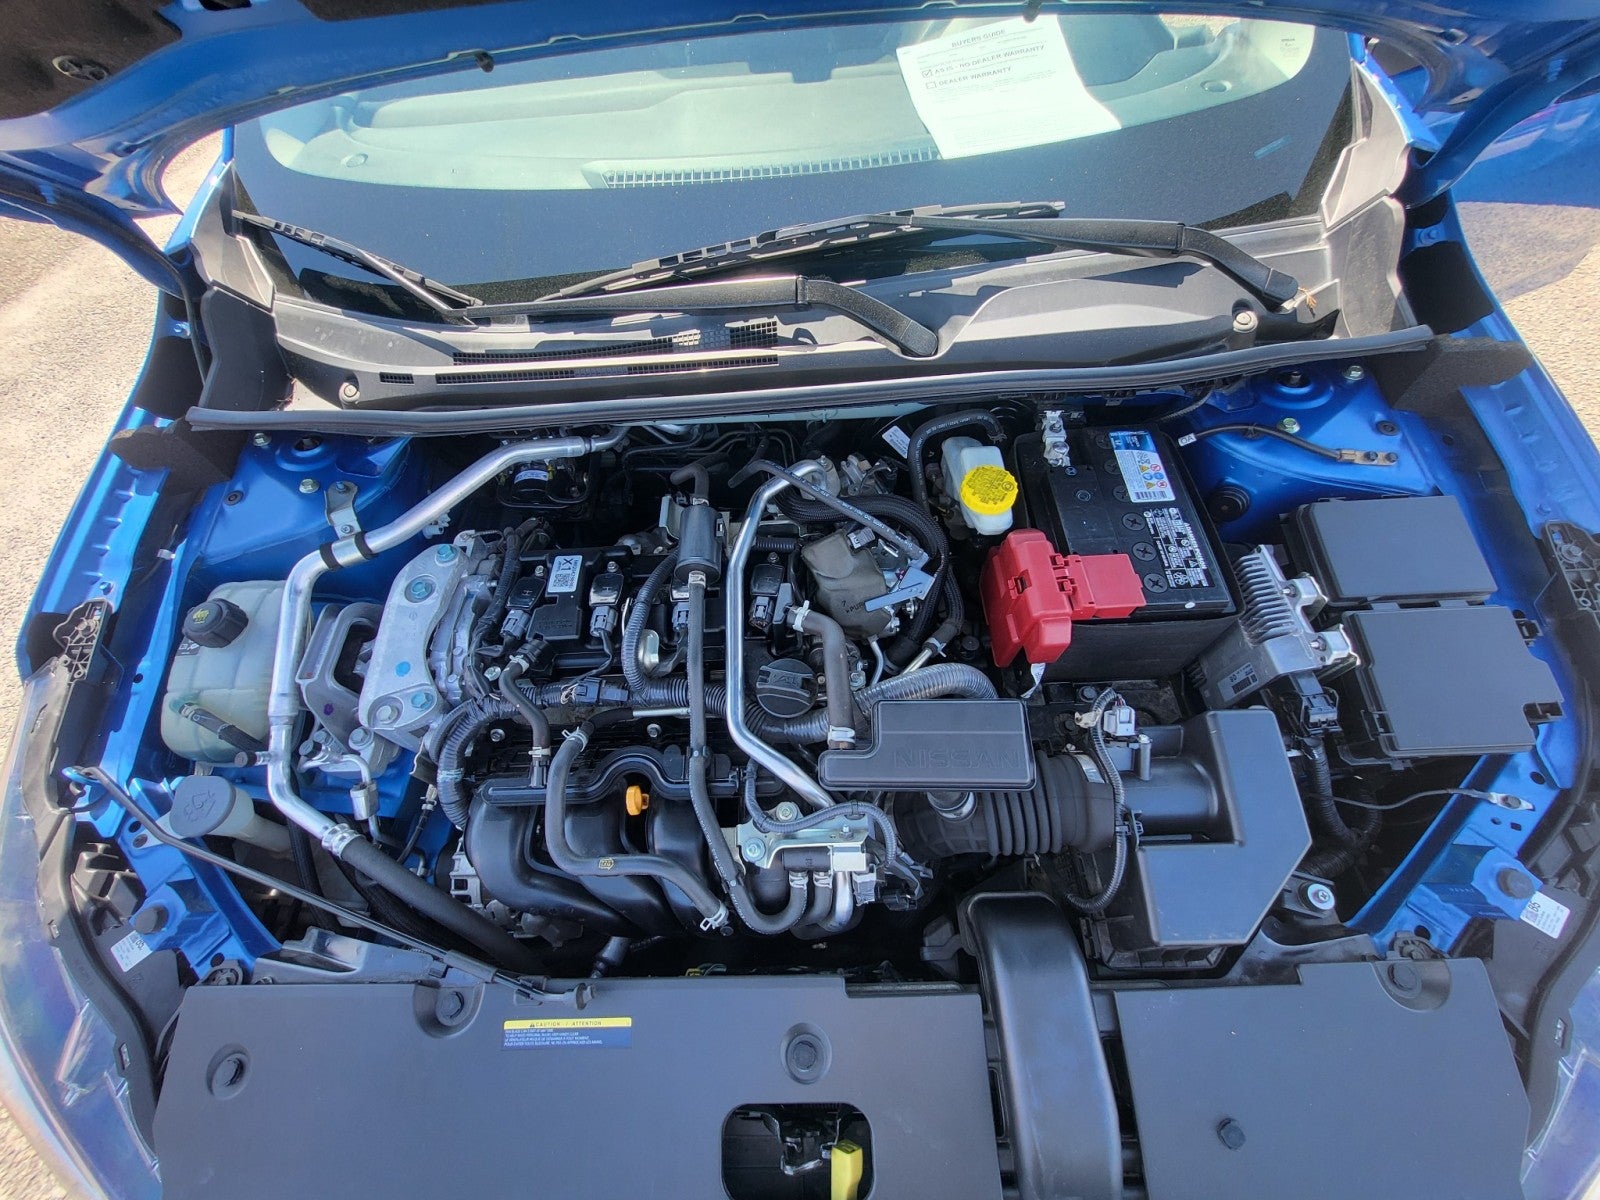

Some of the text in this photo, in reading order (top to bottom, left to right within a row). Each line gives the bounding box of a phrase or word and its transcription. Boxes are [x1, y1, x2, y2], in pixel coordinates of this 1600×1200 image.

[951, 29, 1005, 47] BUYERS GUIDE
[972, 54, 1002, 66] DEALER
[1003, 45, 1044, 57] WARRANTY
[939, 66, 1011, 86] DEALER WARRANTY
[894, 750, 1024, 768] NISSAN
